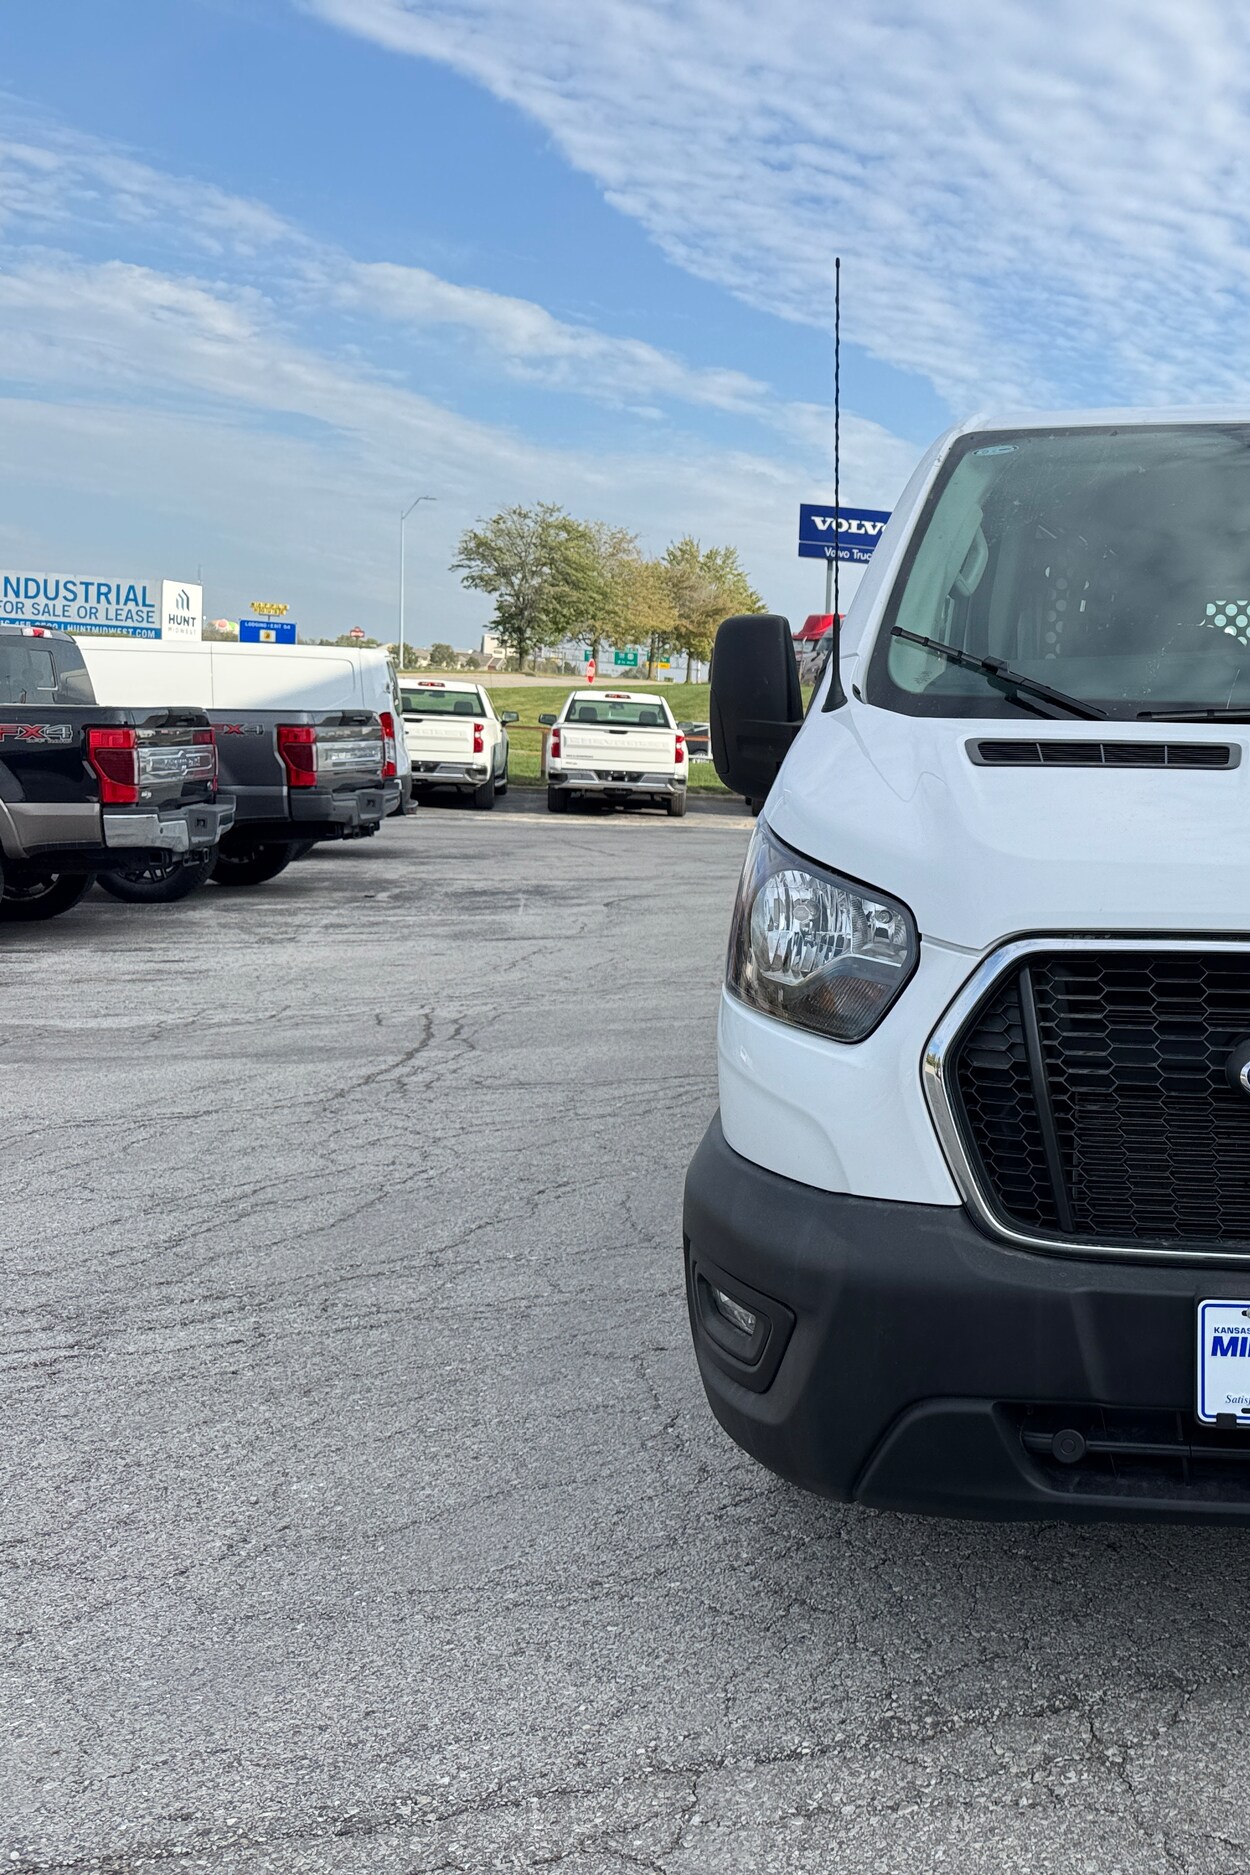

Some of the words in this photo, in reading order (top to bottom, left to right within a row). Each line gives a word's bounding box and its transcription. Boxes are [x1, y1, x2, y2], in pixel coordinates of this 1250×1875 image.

[811, 516, 887, 536] VOLV
[824, 546, 850, 559] Vovo
[852, 549, 873, 560] Truc
[3, 576, 155, 608] NDUSTRIAL
[31, 602, 71, 618] SALE
[77, 605, 99, 620] OR
[105, 607, 156, 624] LEASE
[168, 613, 197, 628] HUNT
